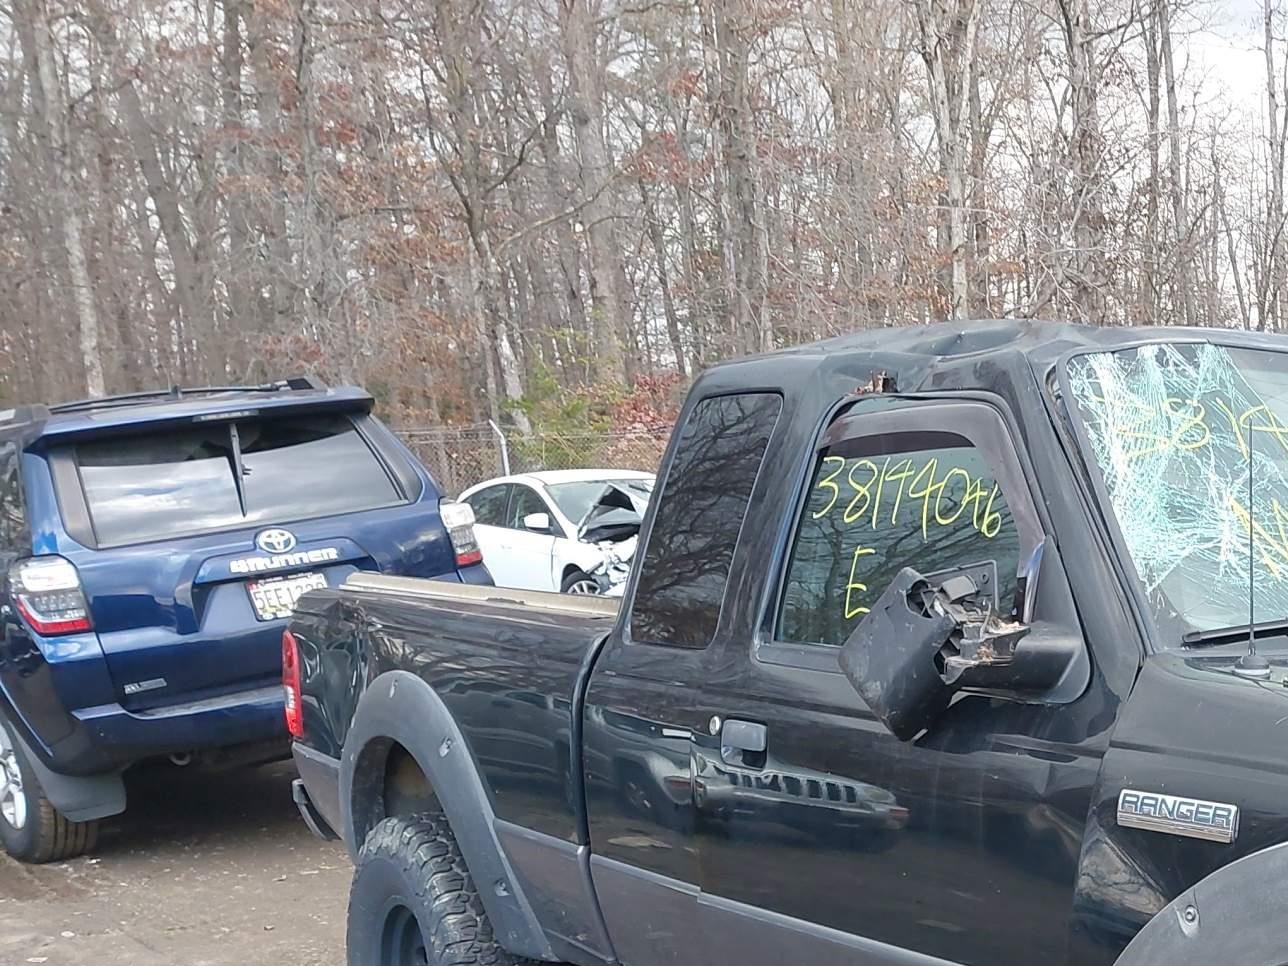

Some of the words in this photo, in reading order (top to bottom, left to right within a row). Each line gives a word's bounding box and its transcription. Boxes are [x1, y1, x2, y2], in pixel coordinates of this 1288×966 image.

[812, 456, 1002, 543] 38144046
[845, 545, 876, 619] E
[1119, 792, 1233, 829] RANGER
